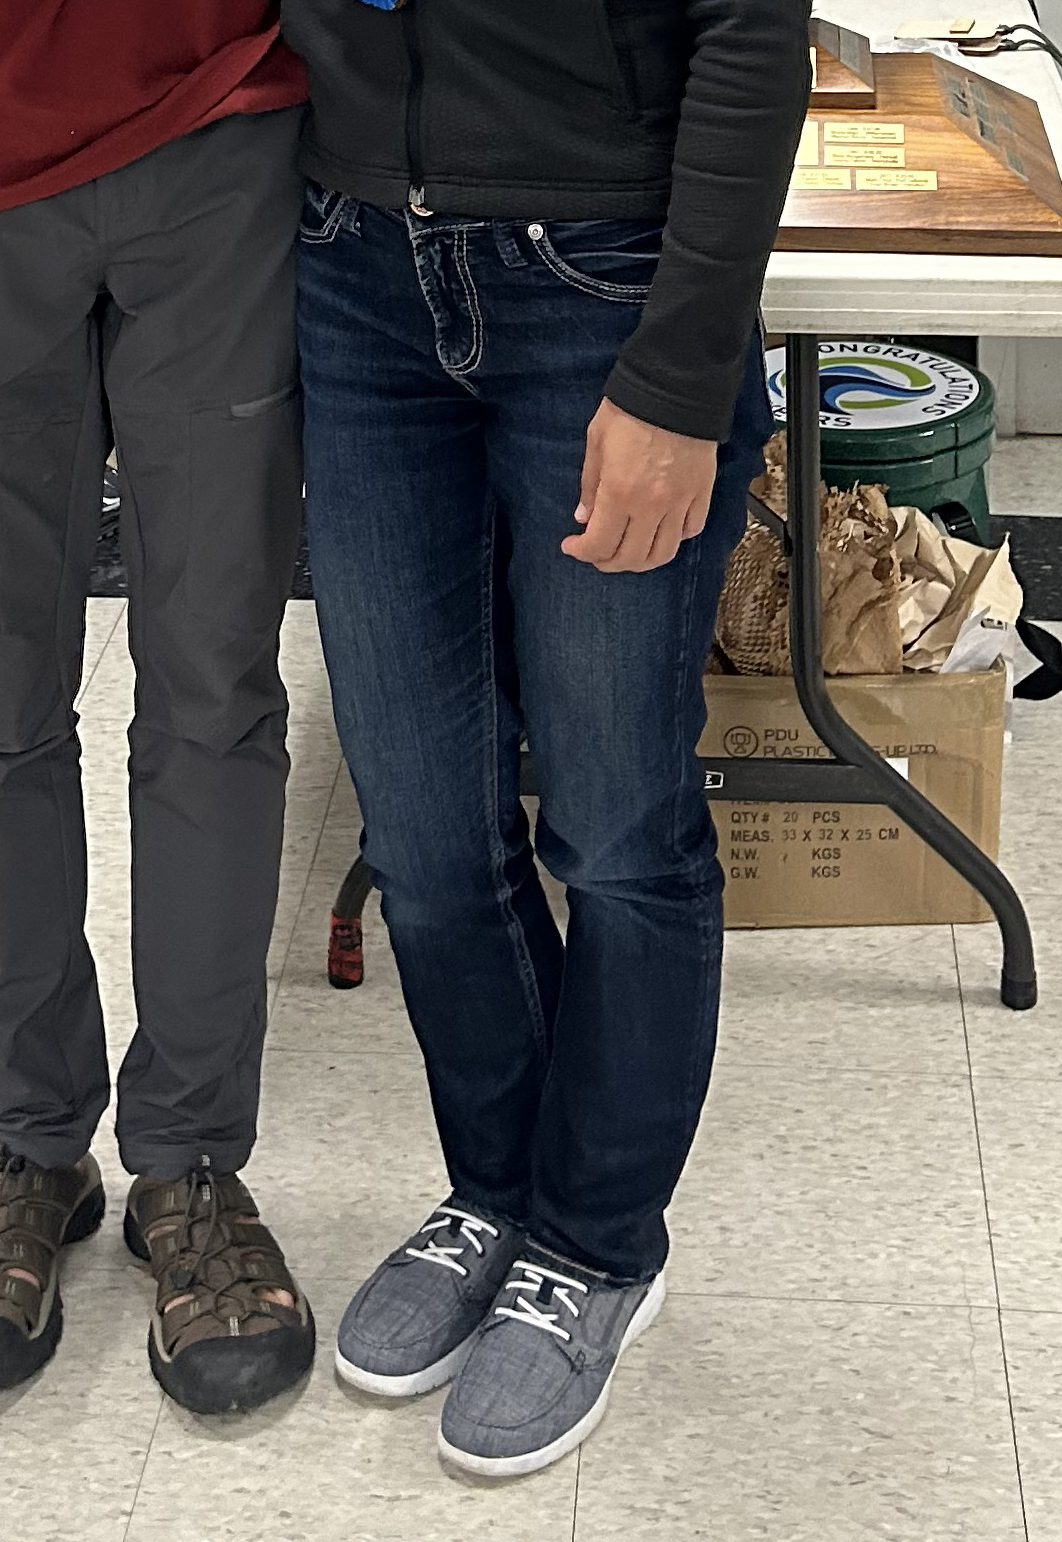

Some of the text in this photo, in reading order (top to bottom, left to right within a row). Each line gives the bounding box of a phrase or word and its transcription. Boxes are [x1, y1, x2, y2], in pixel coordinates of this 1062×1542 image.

[817, 342, 974, 416] ONGRATULATIONS
[763, 729, 799, 742] PDU
[782, 811, 799, 824] 20
[812, 810, 841, 823] PCS
[730, 829, 774, 843] MEAS.
[818, 829, 833, 841] 32
[856, 828, 872, 841] 25
[878, 827, 900, 841] CM
[811, 847, 842, 860] KGS
[811, 865, 841, 879] KGS
